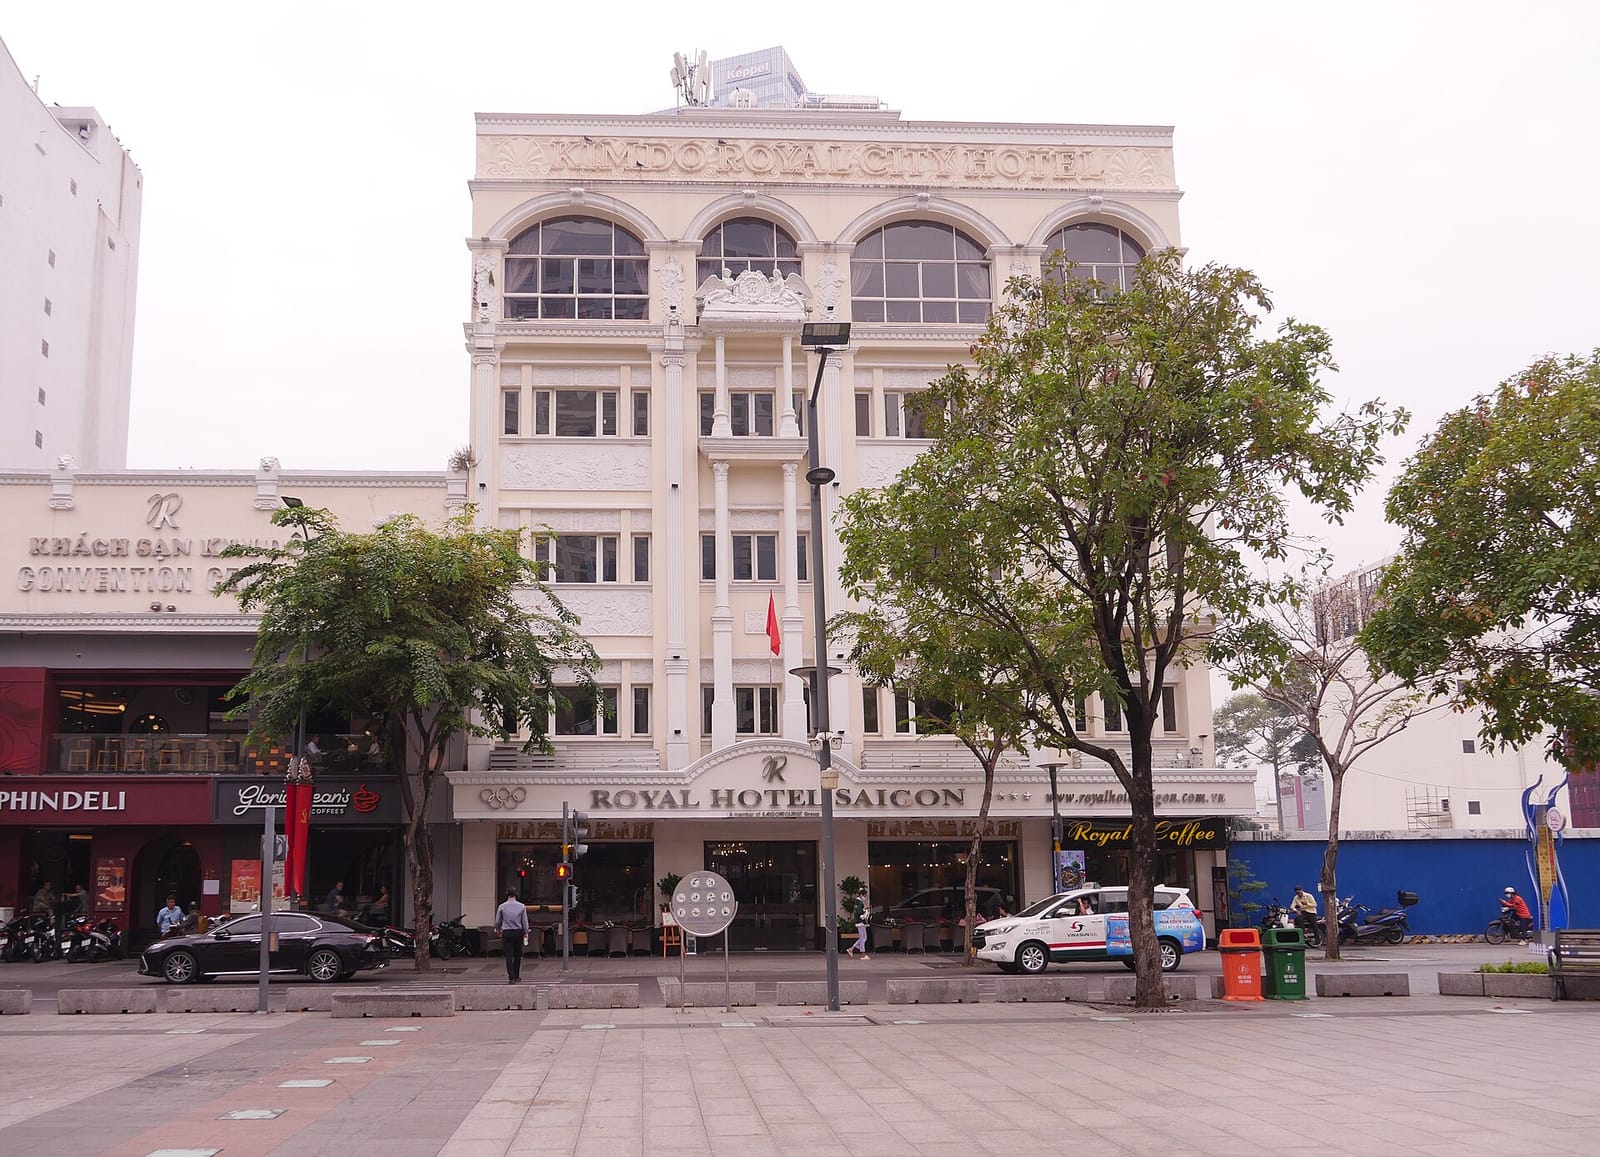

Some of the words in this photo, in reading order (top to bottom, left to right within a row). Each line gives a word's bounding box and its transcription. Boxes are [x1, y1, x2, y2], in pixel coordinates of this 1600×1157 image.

[717, 143, 851, 176] ROYAL
[860, 145, 953, 177] CITY
[964, 148, 1105, 181] HOTEL
[29, 531, 129, 557] KHÁCH
[17, 566, 193, 592] CONVENTION
[0, 791, 126, 811] PHINDELI
[312, 788, 350, 804] ean's
[590, 789, 700, 809] ROYAL
[710, 789, 822, 808] HOTEL
[835, 788, 966, 808] SAIGON
[1068, 820, 1135, 847] Royal
[1155, 821, 1216, 846] Coffee
